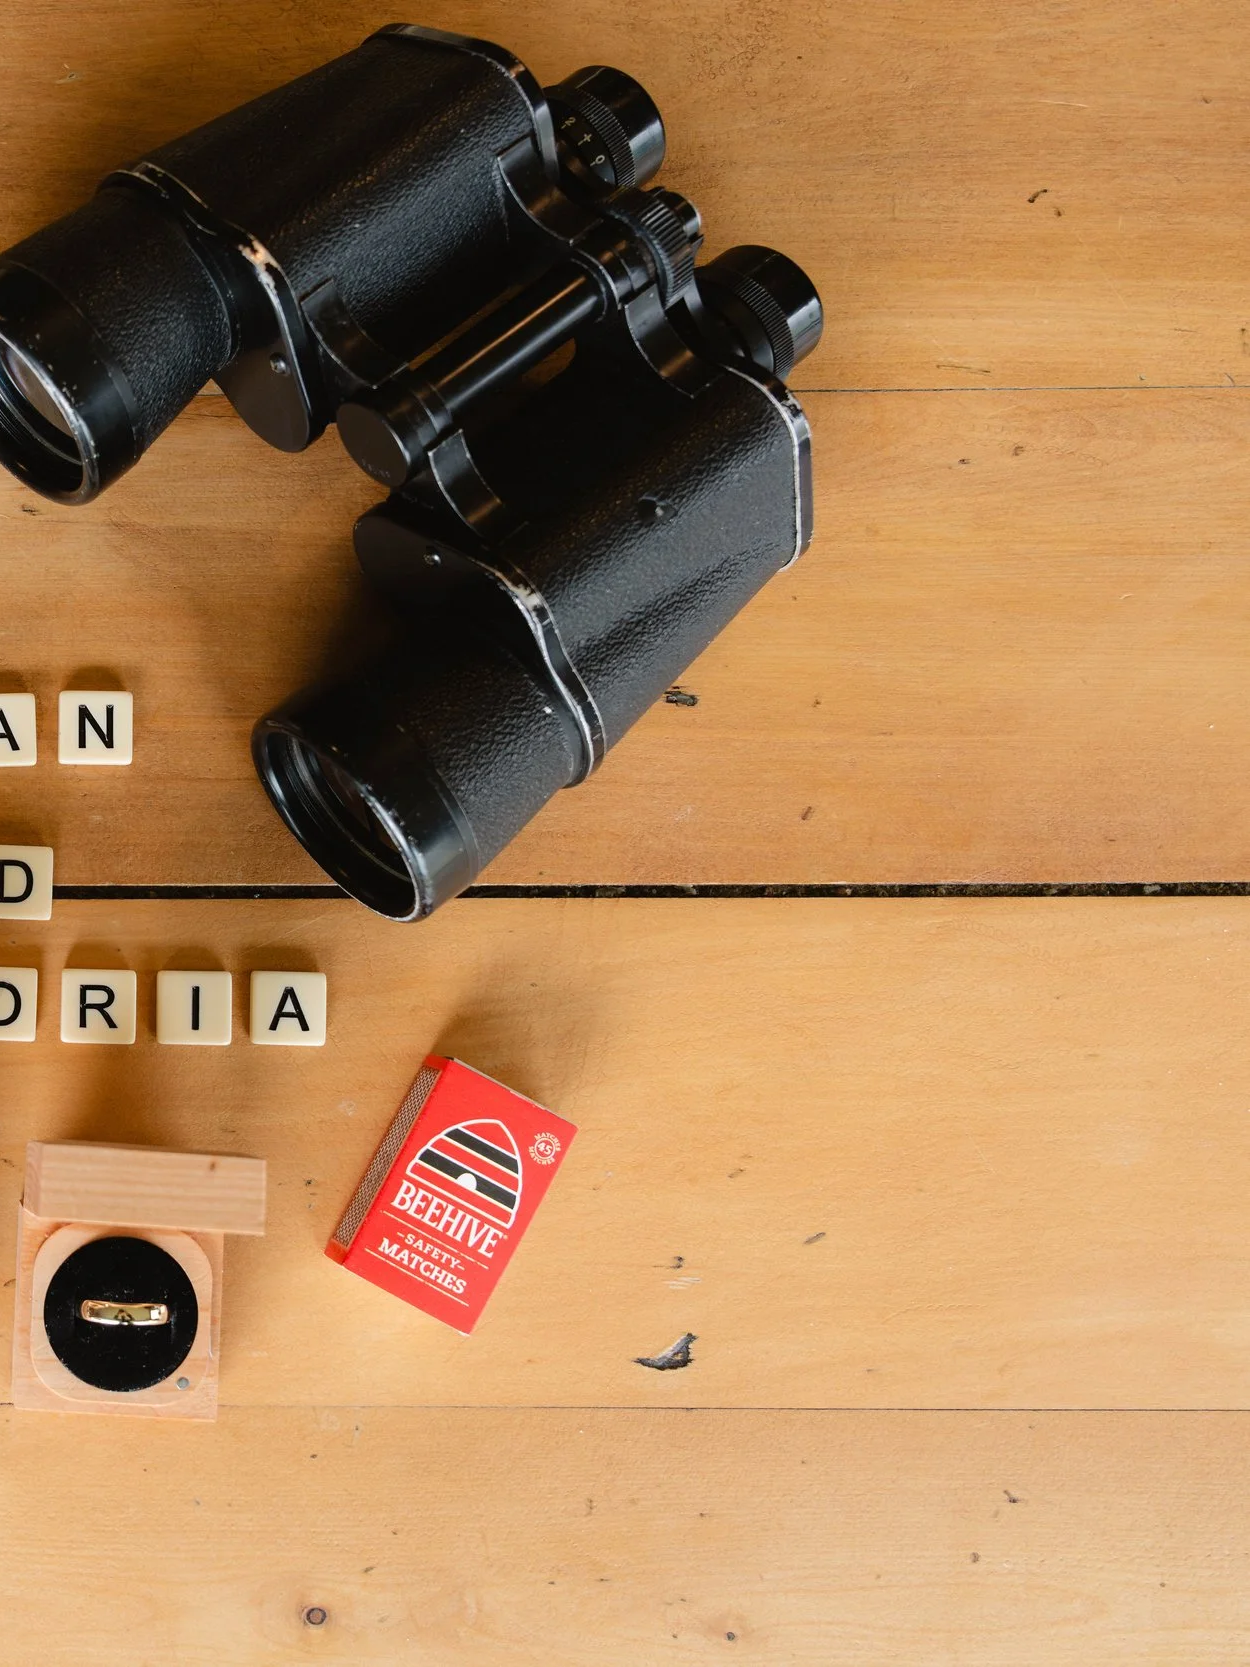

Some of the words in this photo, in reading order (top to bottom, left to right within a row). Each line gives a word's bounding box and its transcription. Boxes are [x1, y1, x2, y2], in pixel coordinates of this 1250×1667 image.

[537, 1142, 553, 1155] 45
[390, 1179, 504, 1259] BEEHIVE
[377, 1237, 468, 1294] MATCHES
